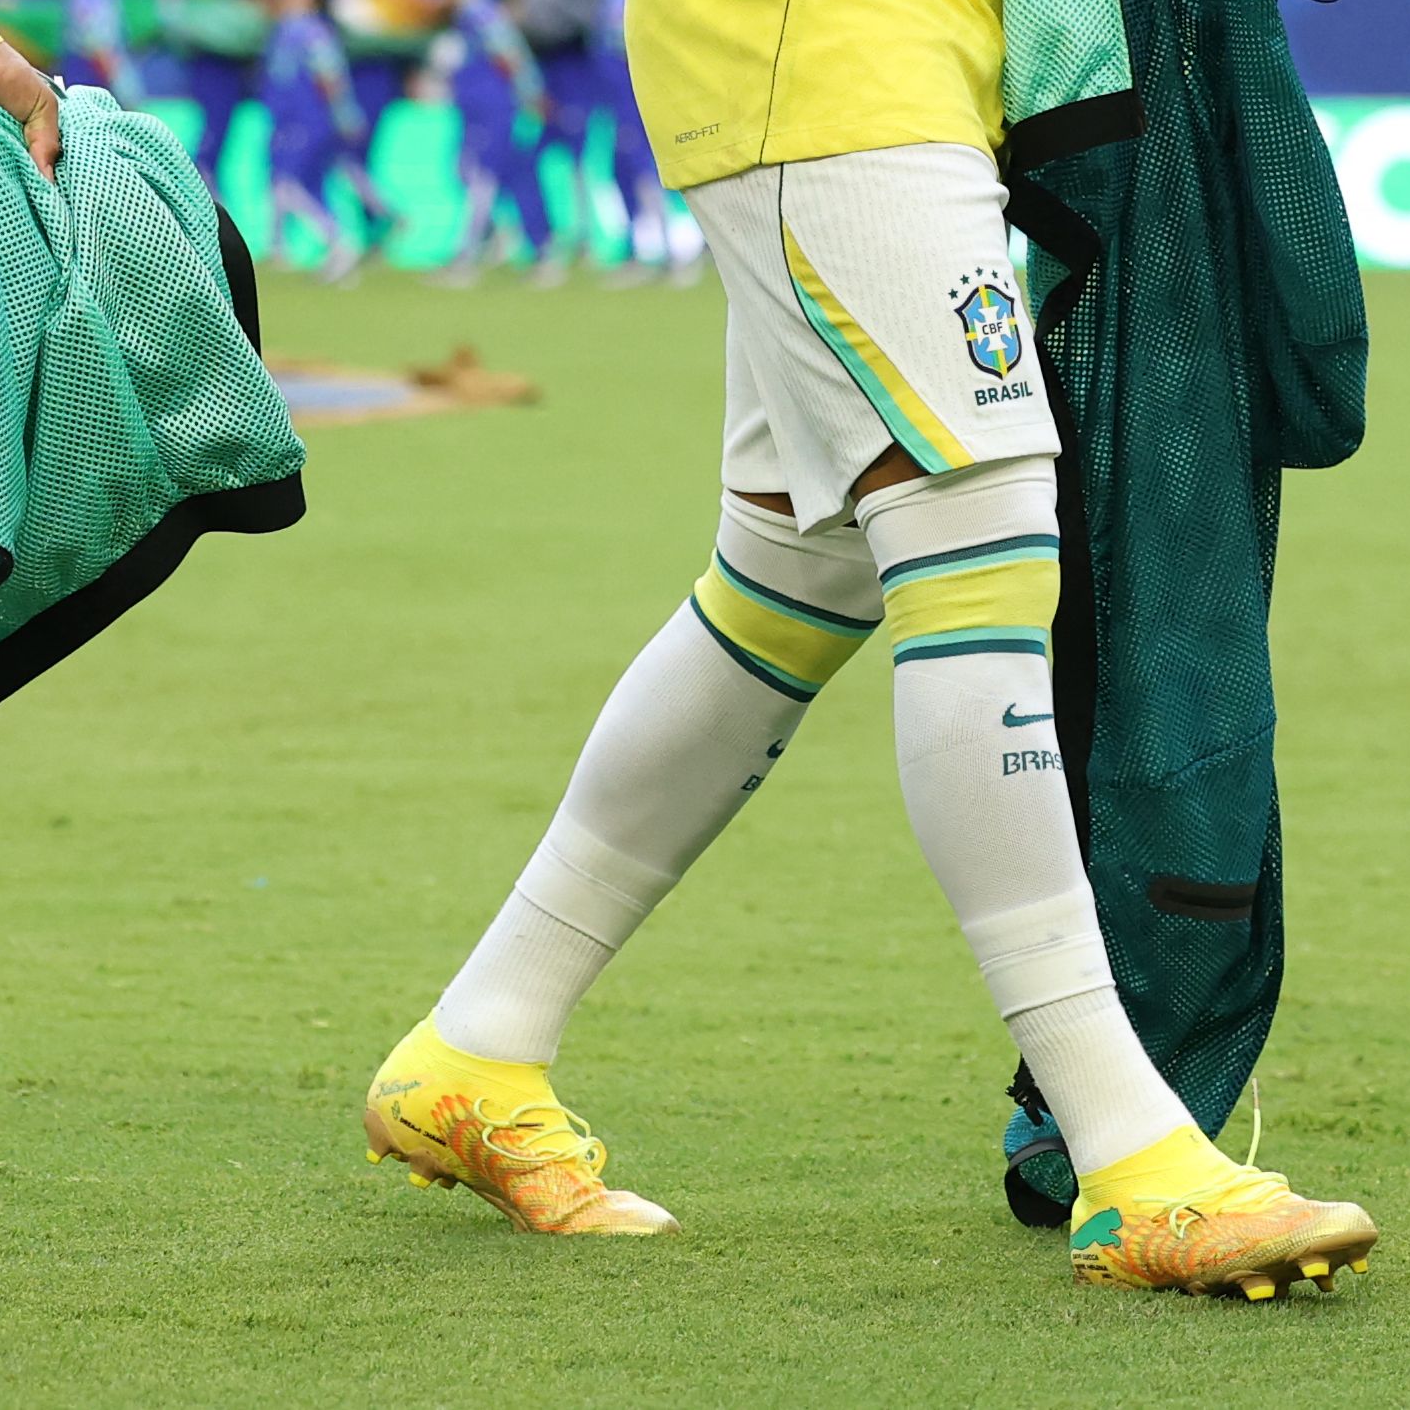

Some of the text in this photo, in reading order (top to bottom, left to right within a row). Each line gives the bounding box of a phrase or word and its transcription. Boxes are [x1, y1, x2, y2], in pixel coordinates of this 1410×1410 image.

[982, 322, 1003, 335] CBF
[974, 381, 1033, 406] BRASIL
[1002, 750, 1064, 776] BRAS
